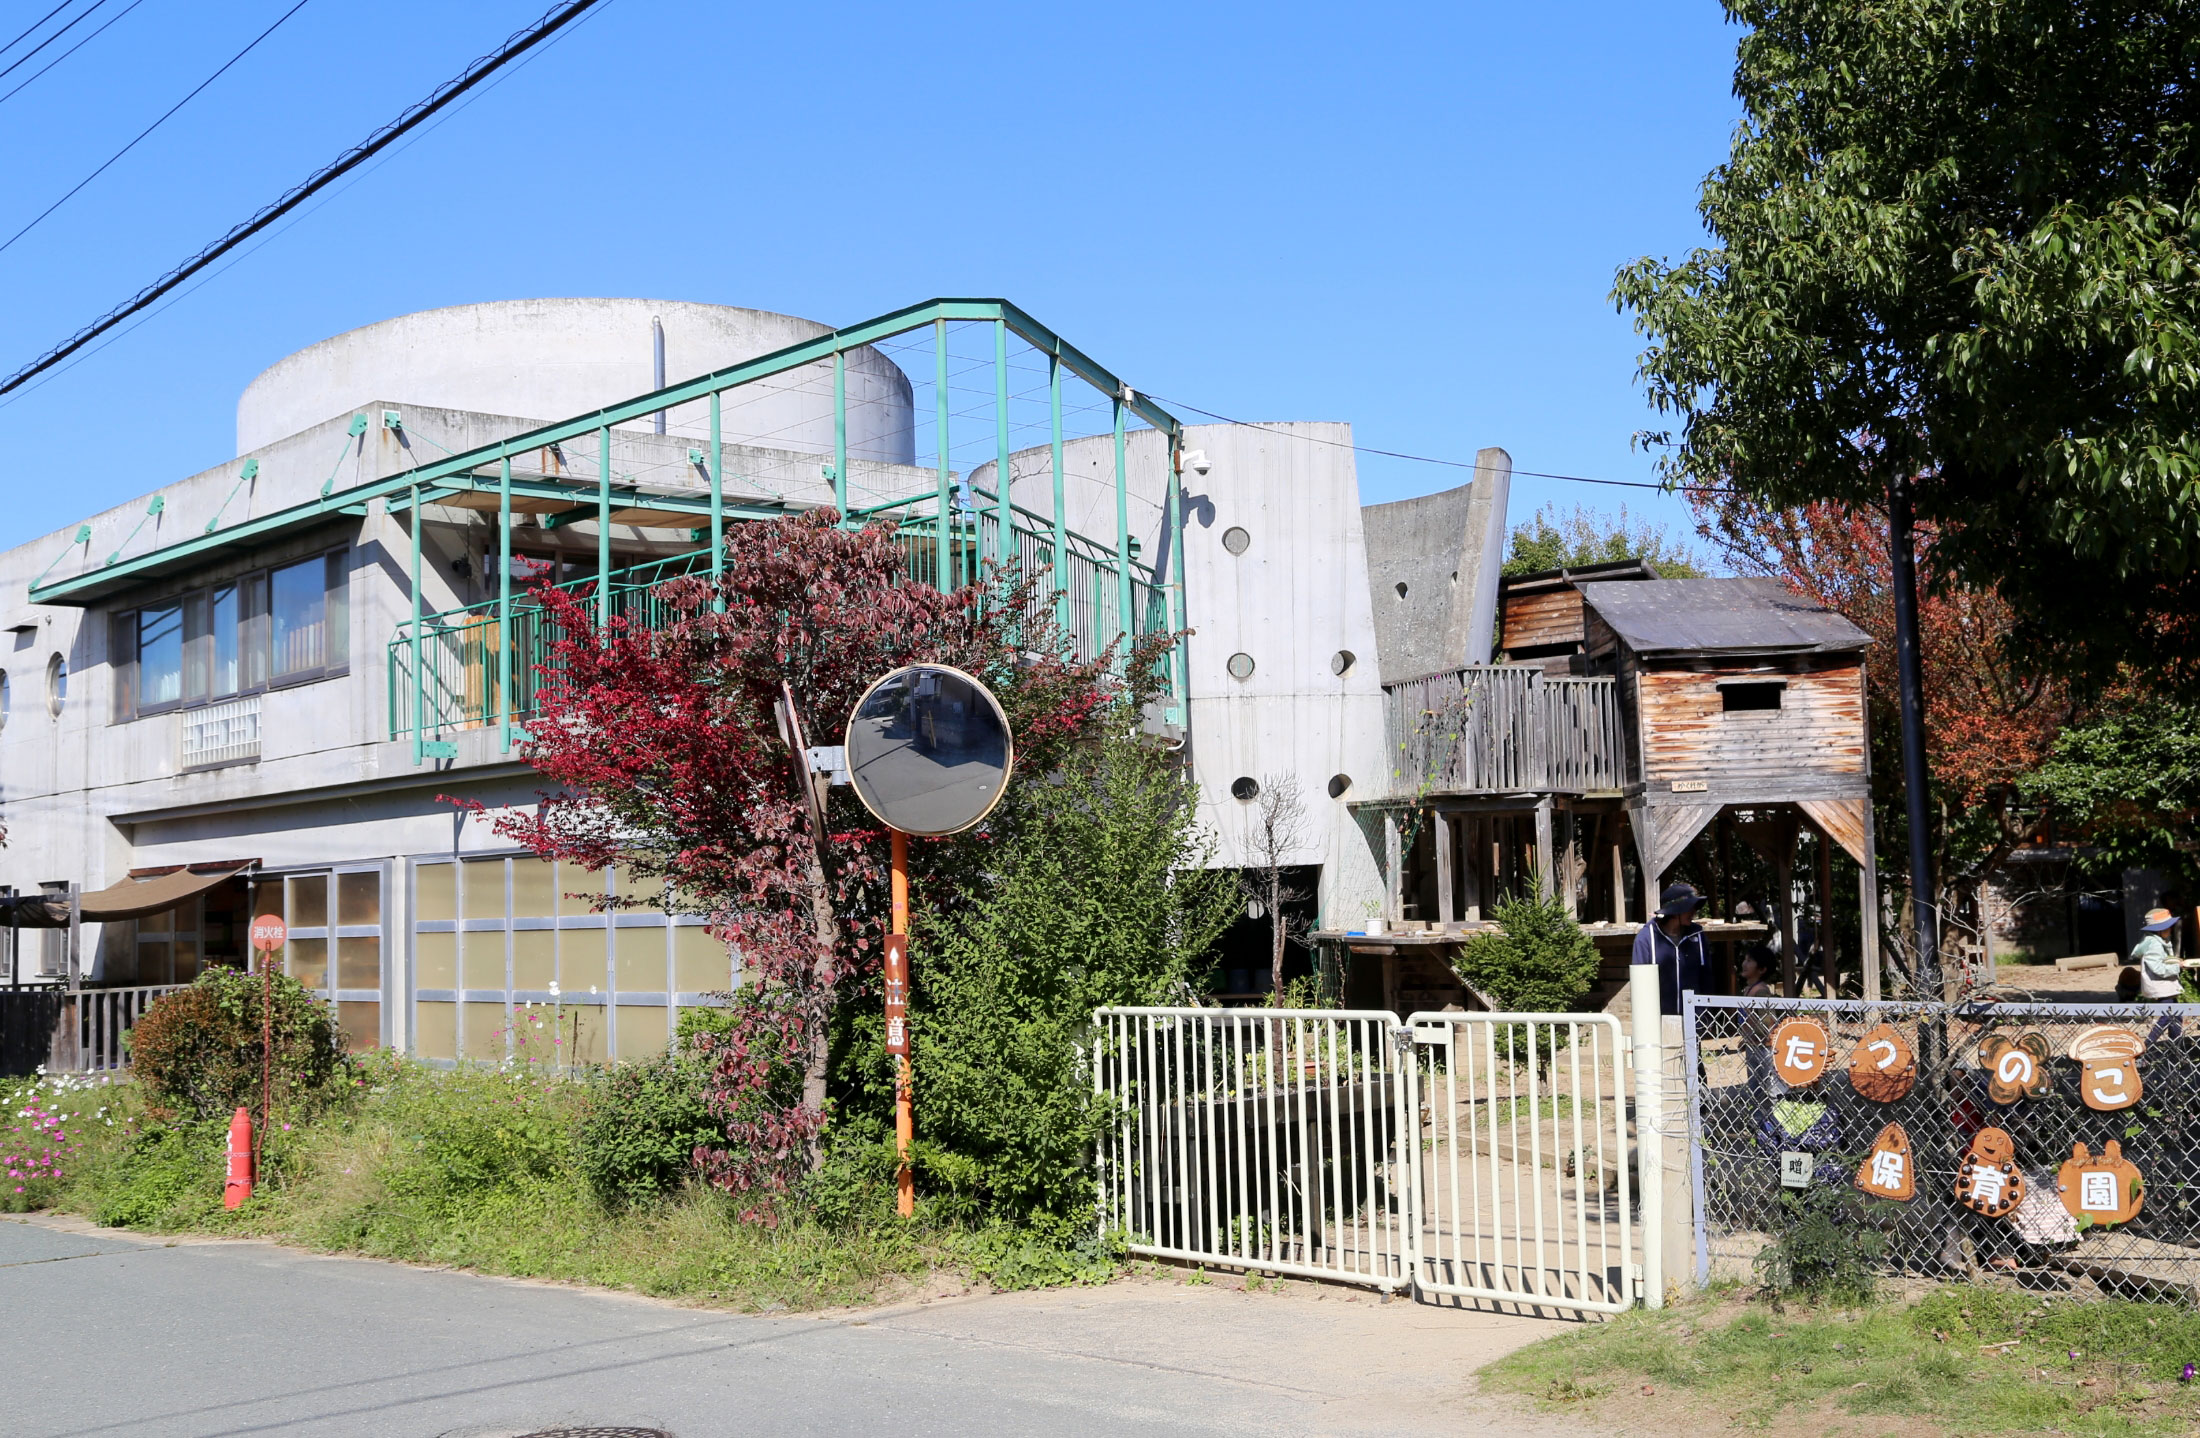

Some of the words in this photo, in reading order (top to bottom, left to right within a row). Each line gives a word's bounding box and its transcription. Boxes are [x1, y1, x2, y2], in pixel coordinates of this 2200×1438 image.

[253, 925, 284, 939] 消火栓
[887, 978, 904, 1046] 注意
[1784, 1036, 2127, 1103] たつのこ
[1789, 1157, 1803, 1175] 贈
[1871, 1149, 2119, 1211] 保育園
